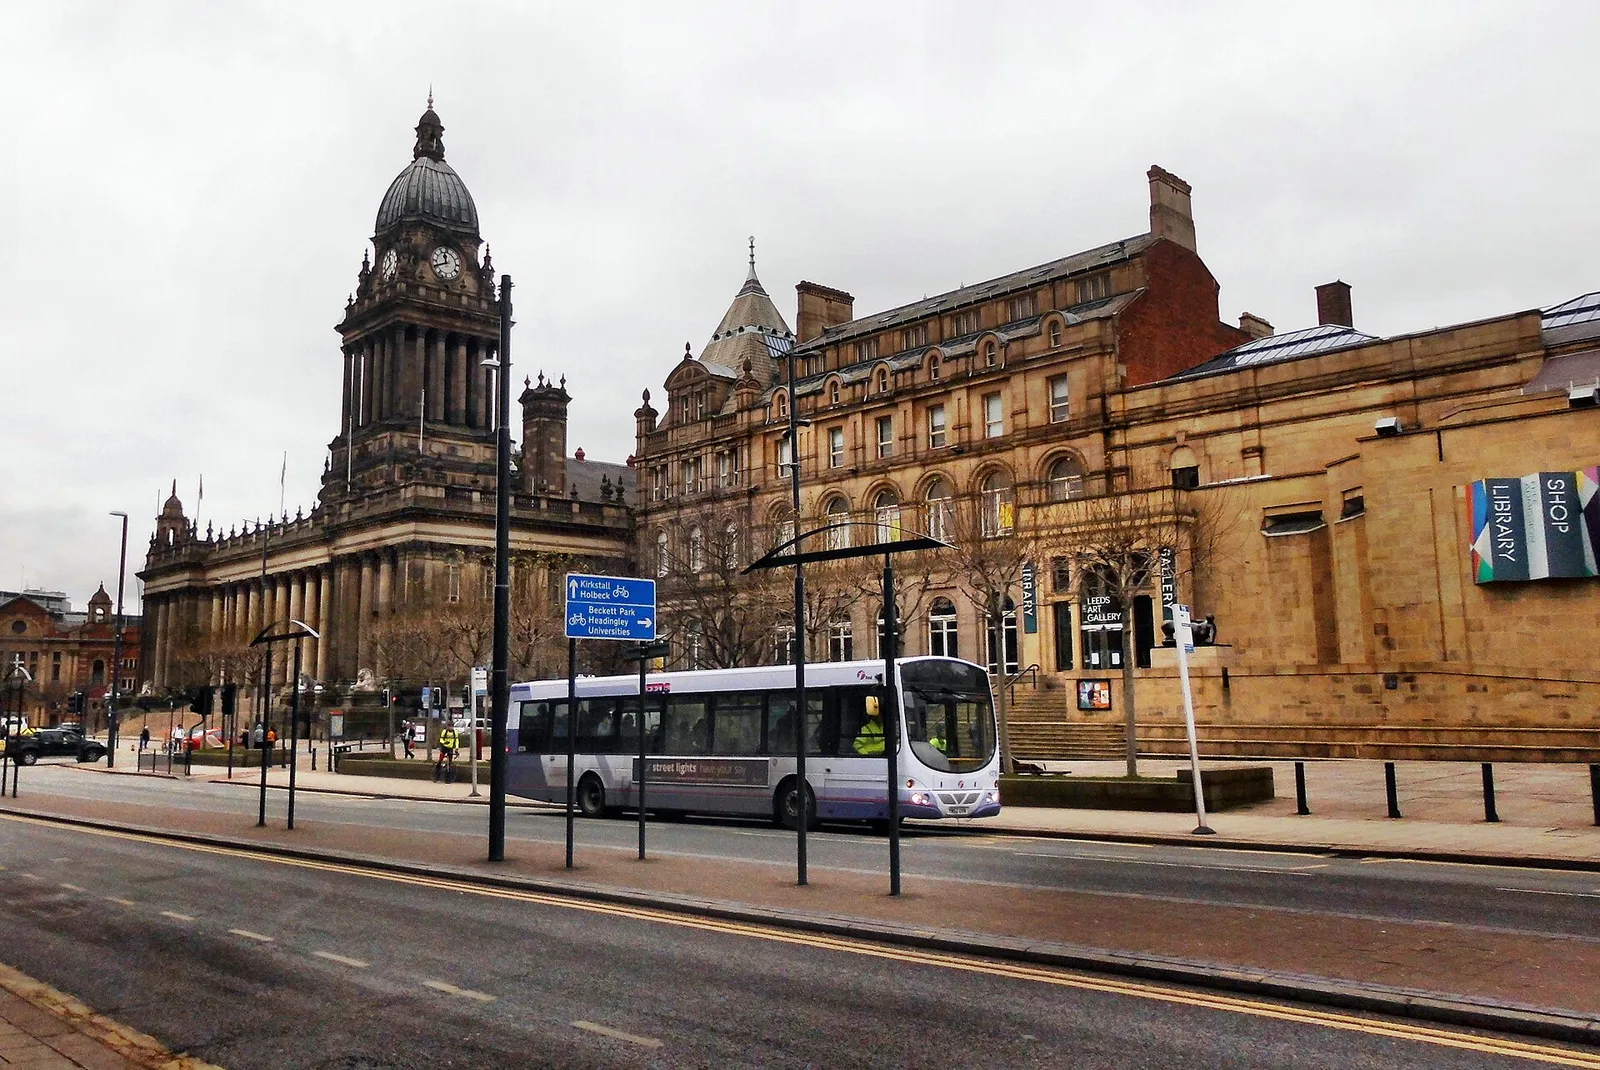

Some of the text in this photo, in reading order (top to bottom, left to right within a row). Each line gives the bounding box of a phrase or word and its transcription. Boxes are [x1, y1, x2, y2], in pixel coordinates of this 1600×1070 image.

[1547, 479, 1570, 533] SHOP
[1493, 485, 1515, 562] LIBRARY
[1161, 548, 1174, 609] GALLERY
[580, 580, 611, 590] Kirkstall
[580, 591, 610, 600] Holbeck
[1087, 596, 1110, 605] LEEDS
[588, 605, 636, 616] Beckett Park
[1087, 605, 1102, 613] ART
[588, 616, 629, 627] Headingley
[1087, 612, 1121, 622] GALLERY
[588, 627, 631, 636] Universities
[652, 763, 674, 773] street
[676, 763, 697, 775] lights
